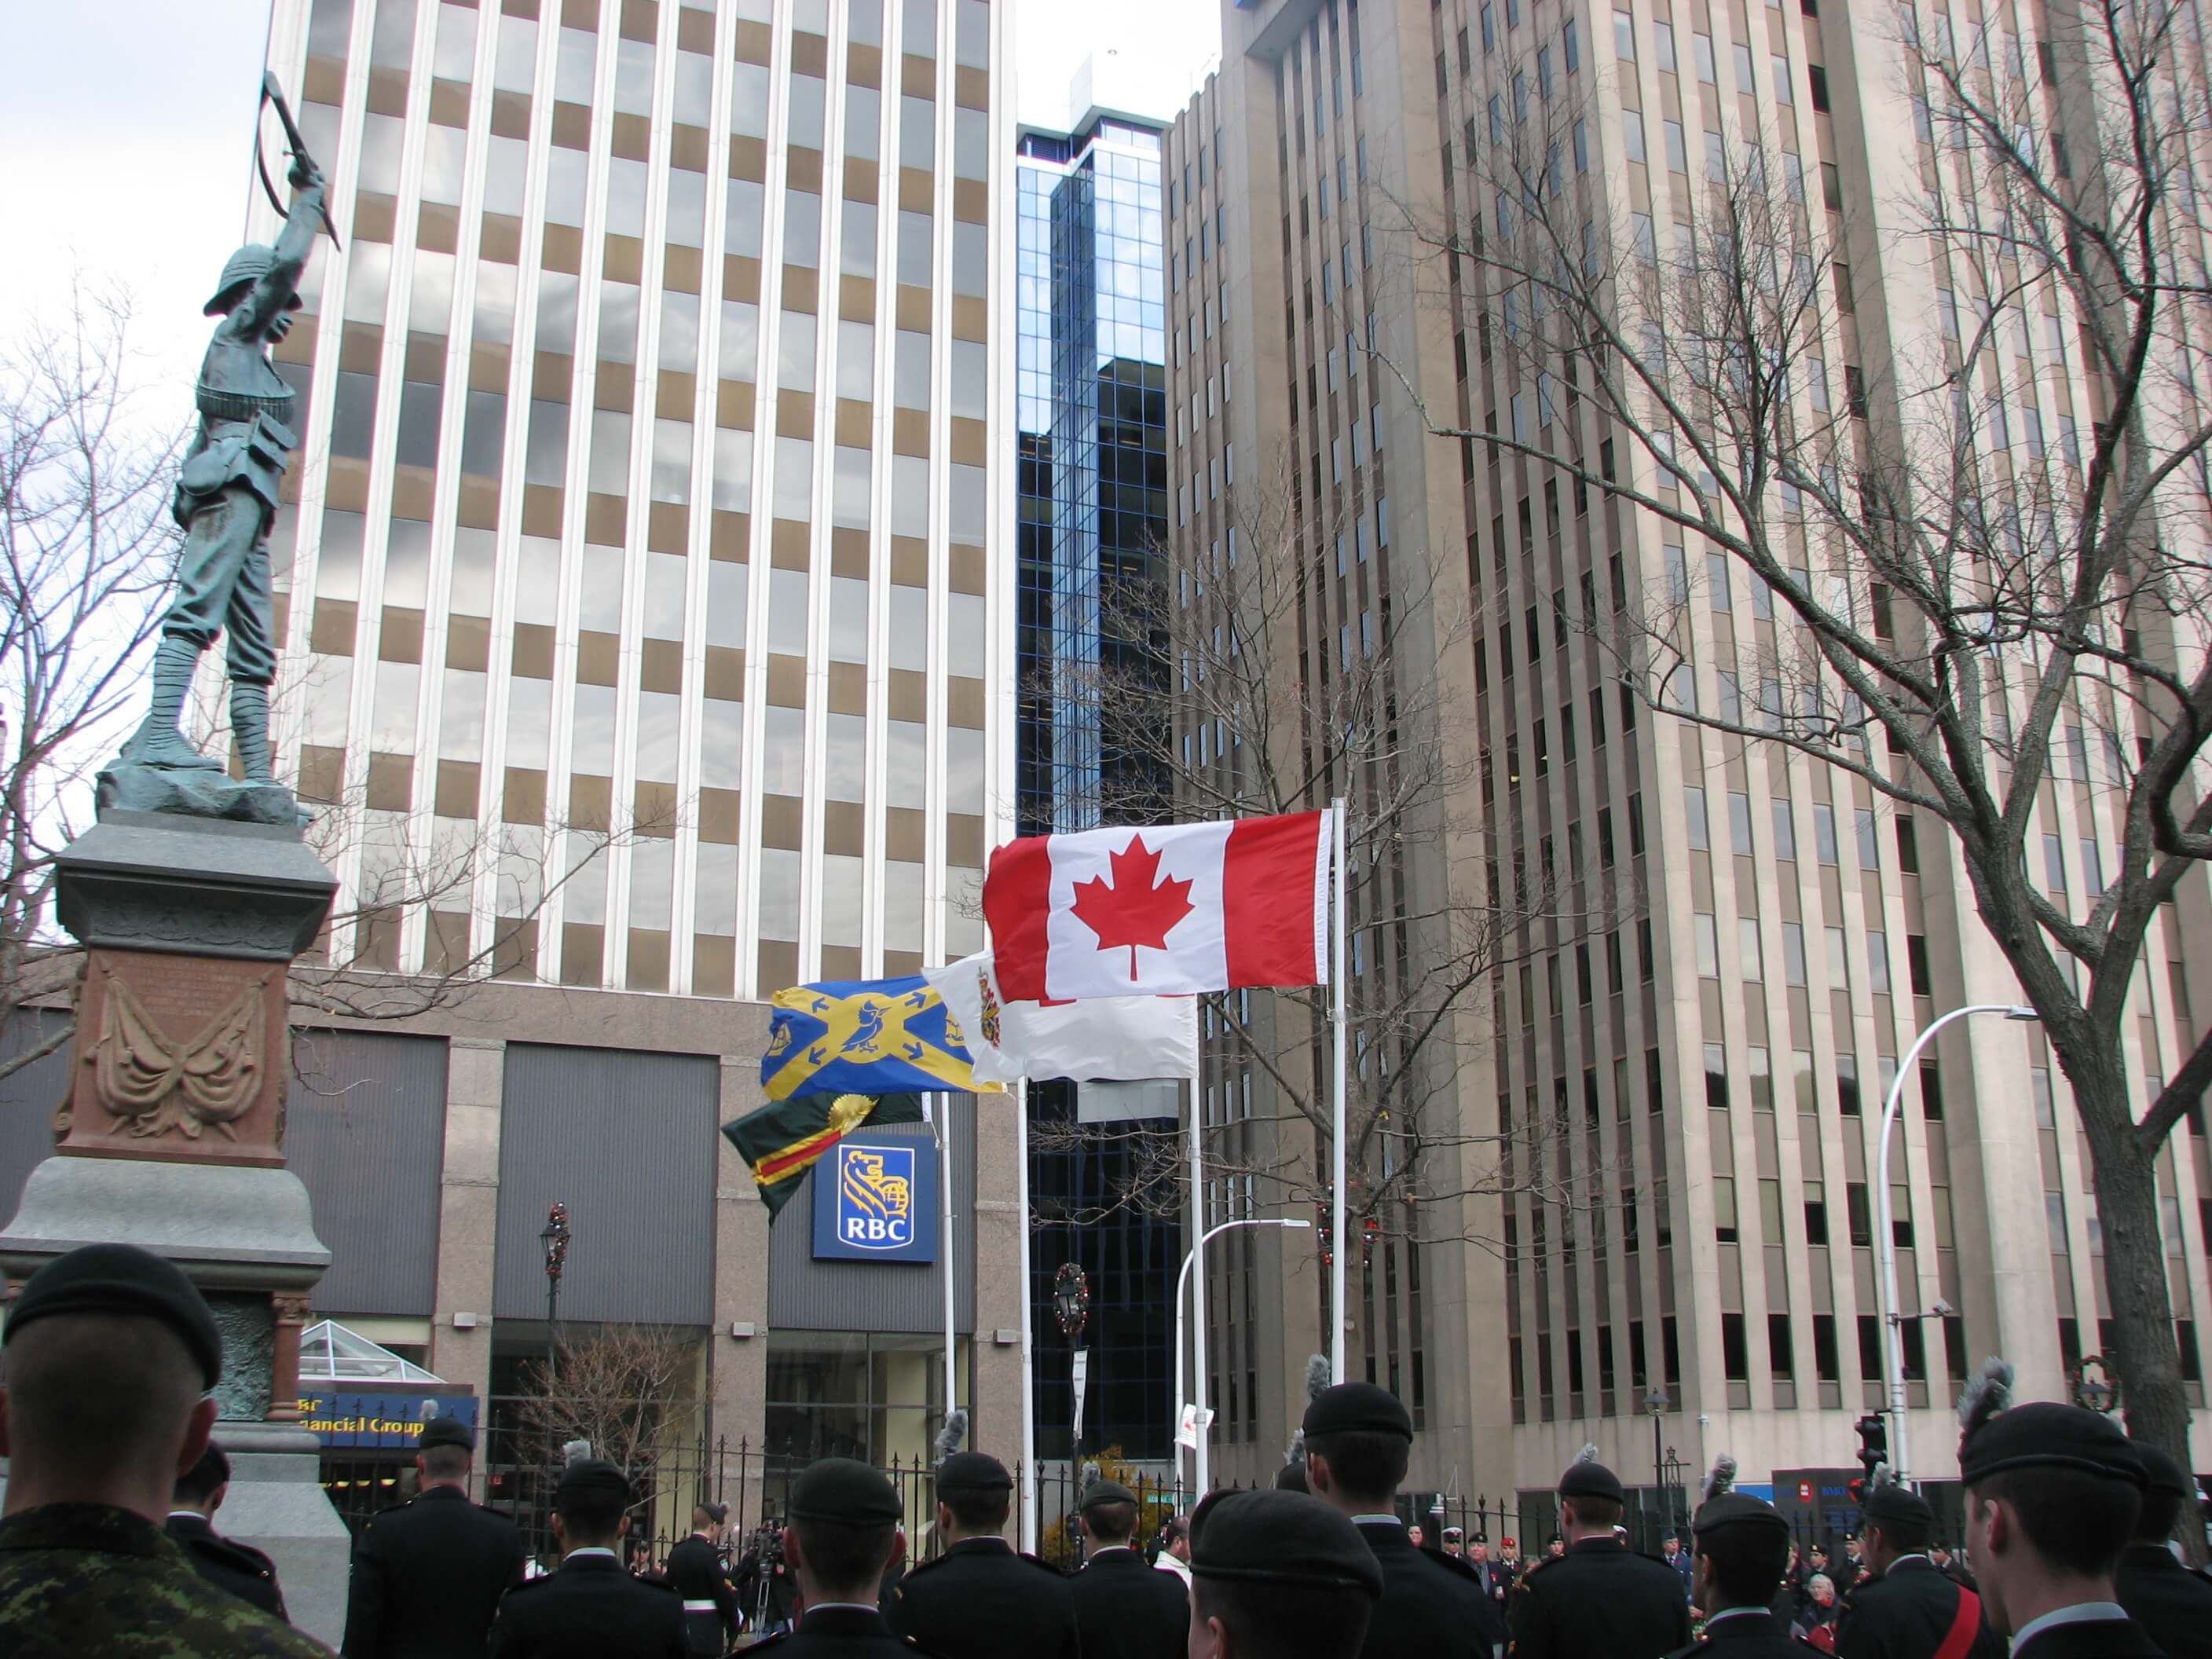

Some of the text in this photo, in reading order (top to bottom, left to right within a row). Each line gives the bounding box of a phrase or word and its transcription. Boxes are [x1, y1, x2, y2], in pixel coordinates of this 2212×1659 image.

[848, 1218, 906, 1240] RBC
[299, 1416, 425, 1437] nancial Group
